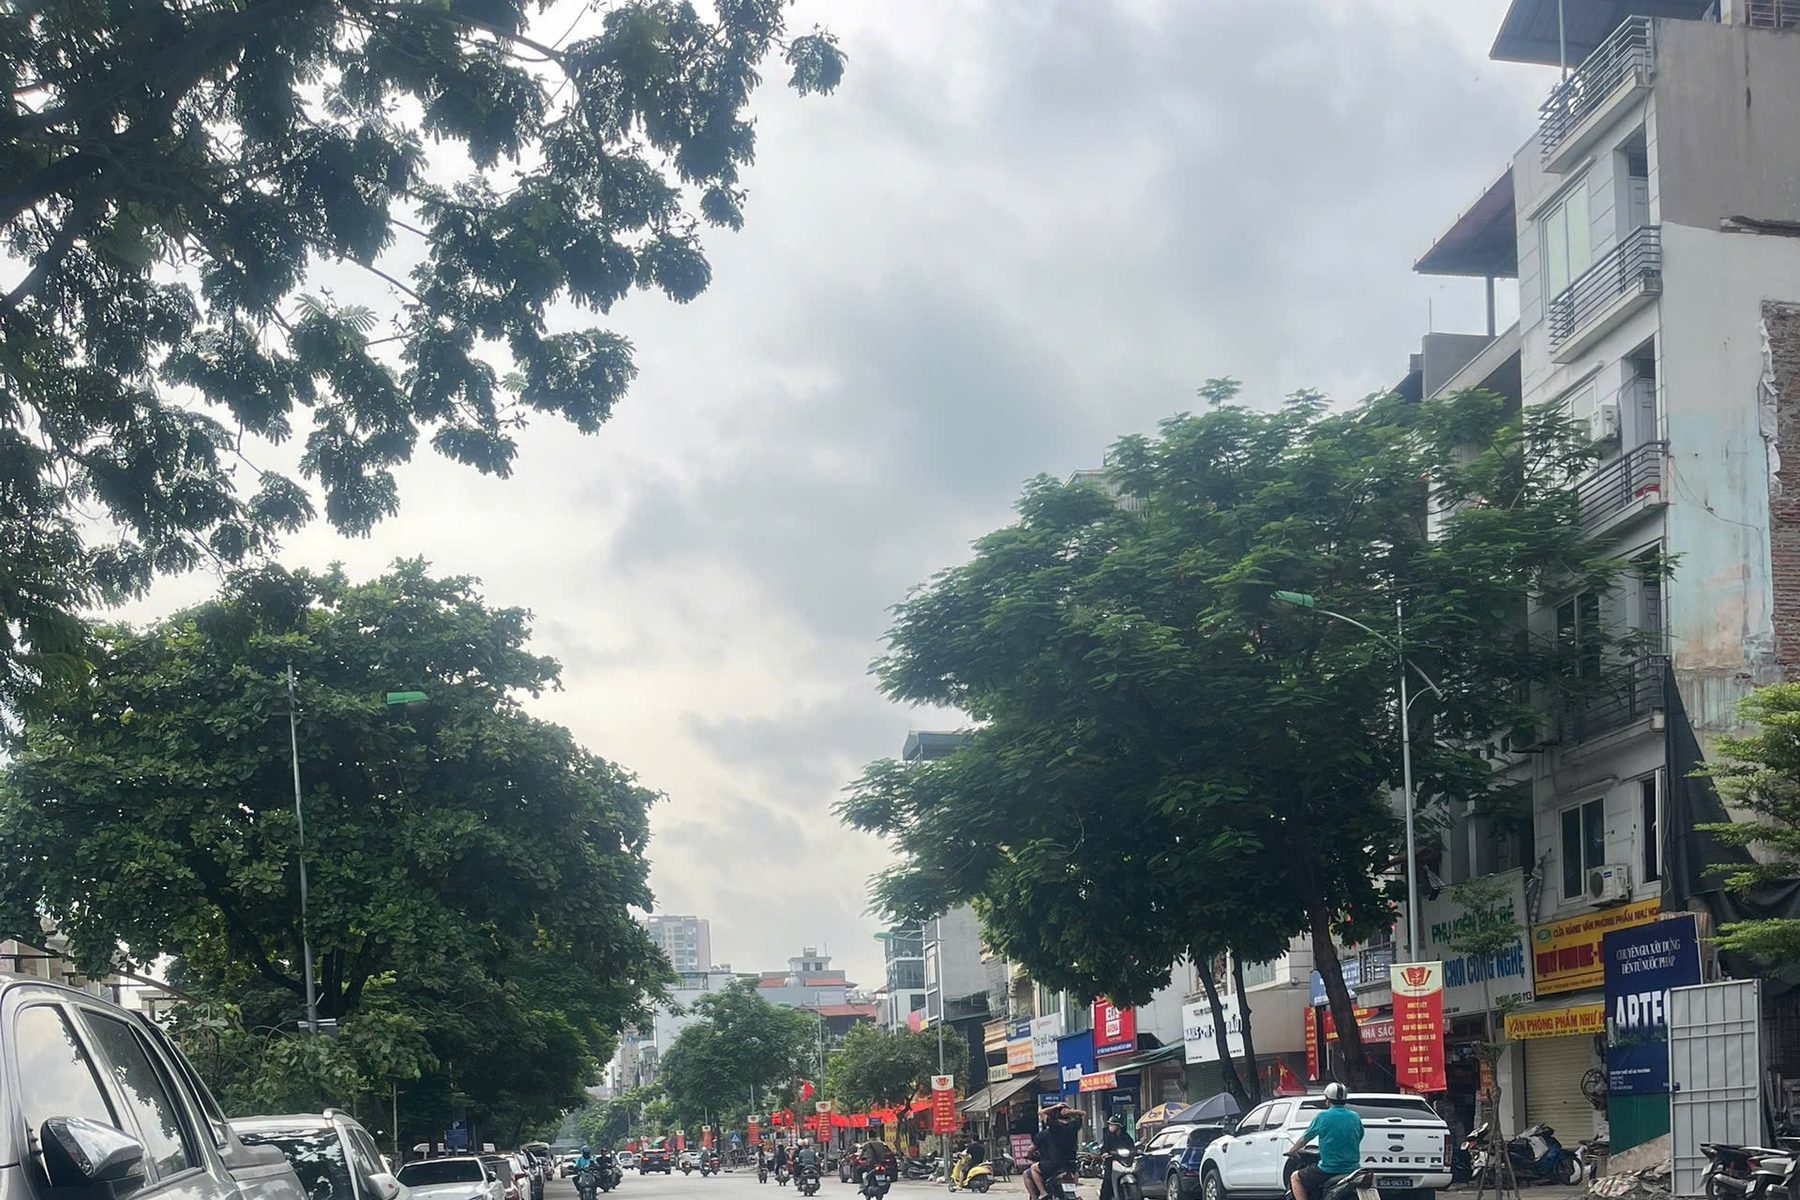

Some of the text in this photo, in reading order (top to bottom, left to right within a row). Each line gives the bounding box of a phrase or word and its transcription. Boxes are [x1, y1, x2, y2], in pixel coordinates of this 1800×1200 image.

[1527, 1015, 1553, 1031] PHÒNG
[1555, 1008, 1577, 1028] PHẨM
[1378, 1024, 1394, 1037] SÁC
